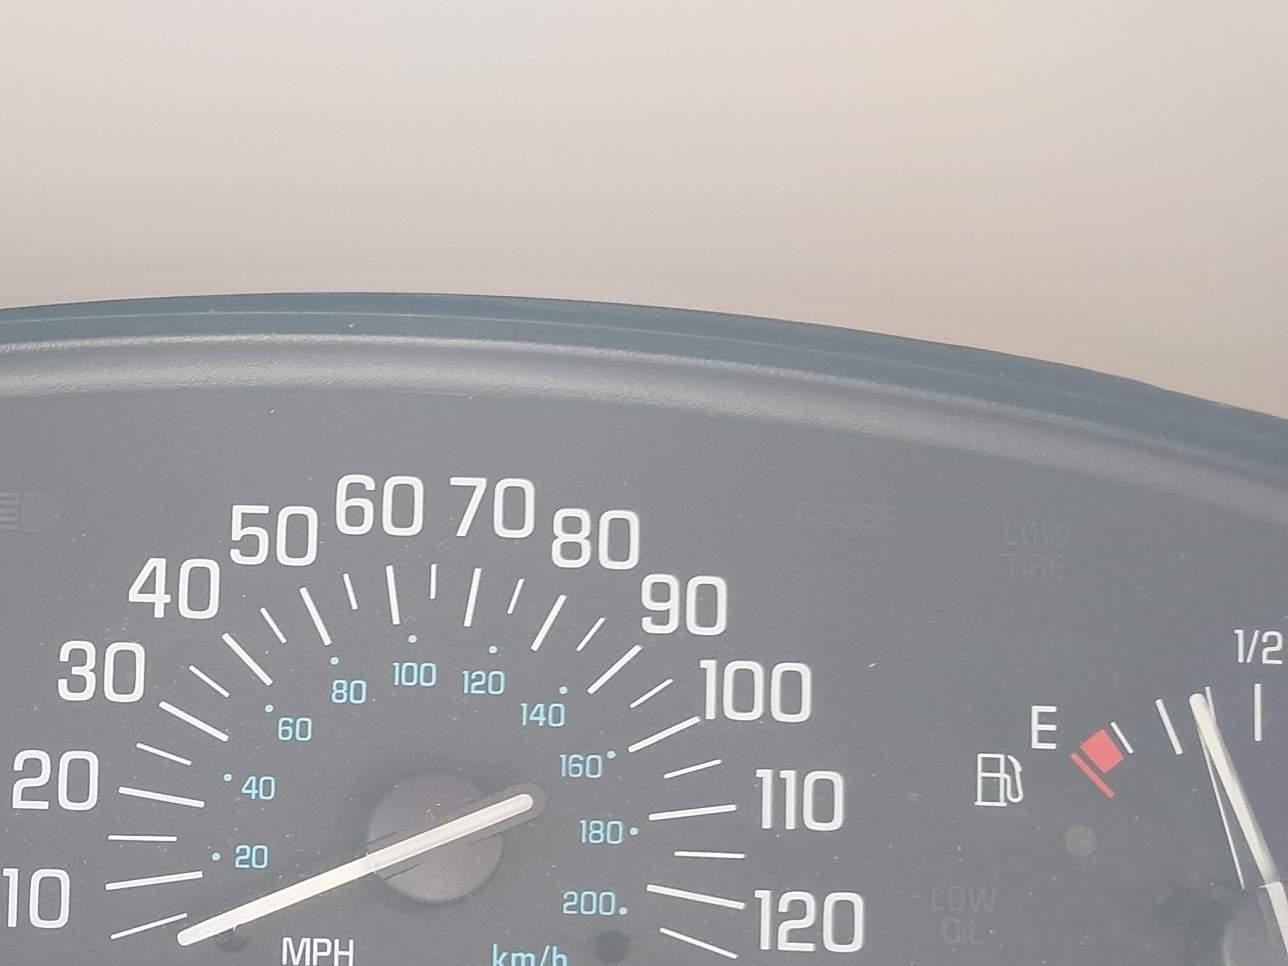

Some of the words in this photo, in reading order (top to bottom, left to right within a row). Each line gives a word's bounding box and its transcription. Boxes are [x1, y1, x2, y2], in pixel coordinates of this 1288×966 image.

[335, 474, 424, 537] 60
[449, 476, 535, 539] 70
[229, 504, 318, 567] 50
[551, 508, 640, 570] 80
[1002, 519, 1073, 548] LOW
[128, 557, 220, 620] 40
[641, 573, 727, 636] 90
[1234, 629, 1283, 665] 1/2
[57, 640, 146, 703] 30
[331, 679, 367, 704] 80
[392, 662, 437, 687] 100
[462, 670, 505, 695] 120
[699, 659, 812, 723] 100
[278, 717, 312, 741] 60
[520, 703, 565, 727] 140
[1031, 705, 1057, 750] E
[12, 749, 99, 811] 20
[559, 754, 602, 779] 160
[241, 775, 276, 800] 40
[755, 768, 844, 831] 110
[580, 819, 623, 845] 180
[235, 844, 268, 869] 20
[2, 868, 71, 929] 10
[563, 891, 616, 916] 200
[931, 885, 998, 913] LOW
[754, 889, 864, 953] 120
